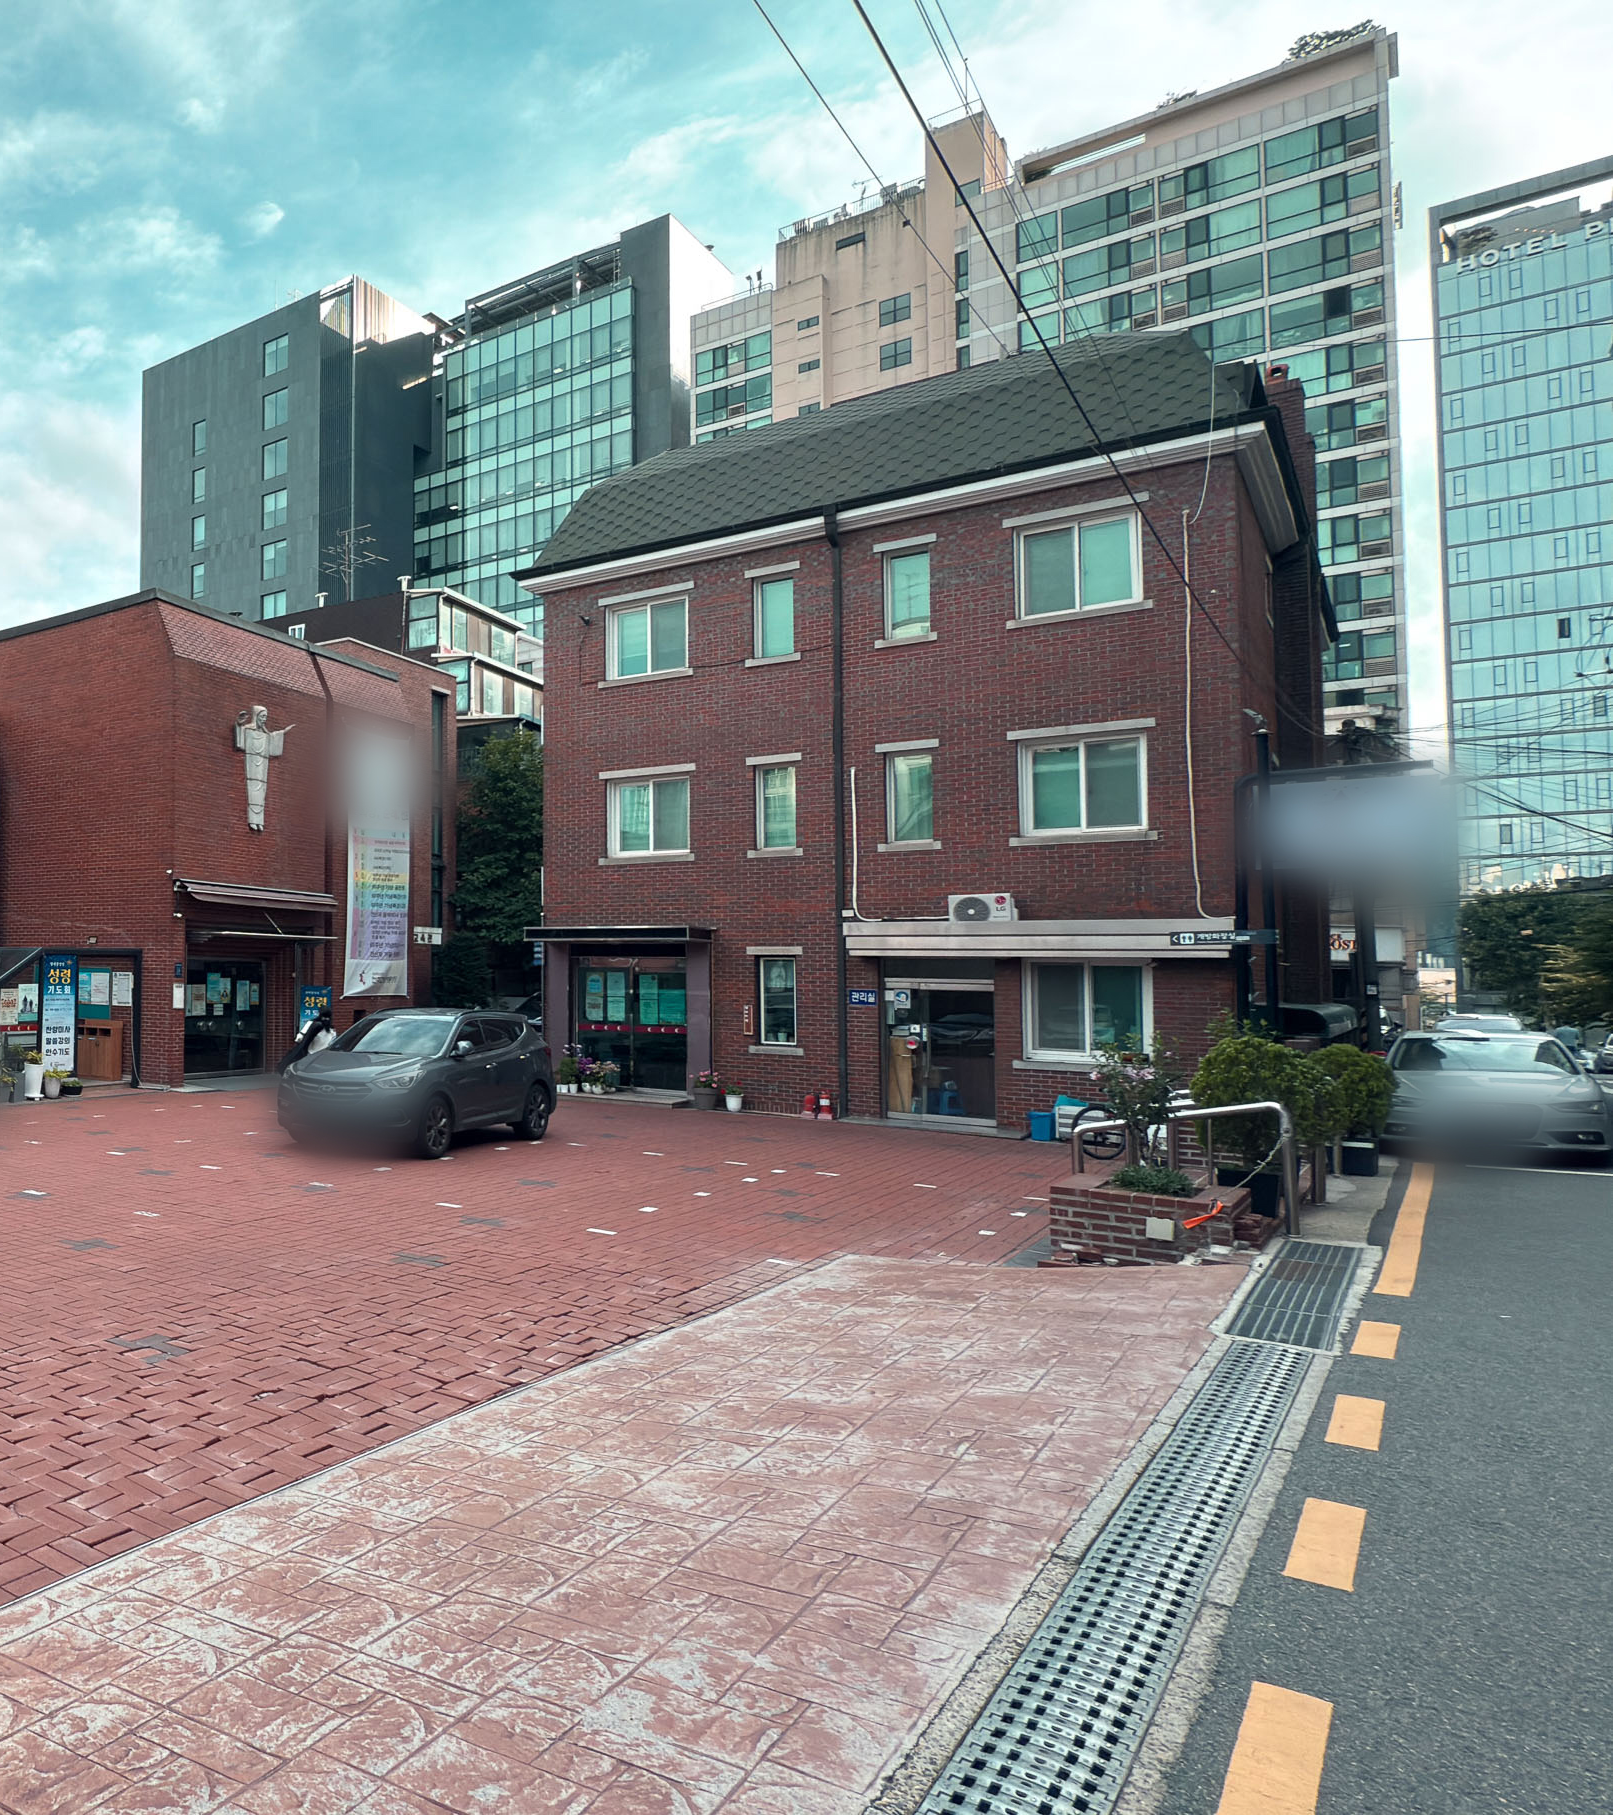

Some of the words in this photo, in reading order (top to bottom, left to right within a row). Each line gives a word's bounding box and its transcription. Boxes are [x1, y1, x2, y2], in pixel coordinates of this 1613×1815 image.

[1456, 233, 1568, 275] HOTEL
[1196, 932, 1236, 940] 개방화장실
[47, 968, 71, 985] 성령
[47, 985, 71, 995] 기도회
[304, 996, 328, 1008] 성령
[851, 991, 876, 1003] 관리실
[45, 1047, 71, 1057] 안수기도
